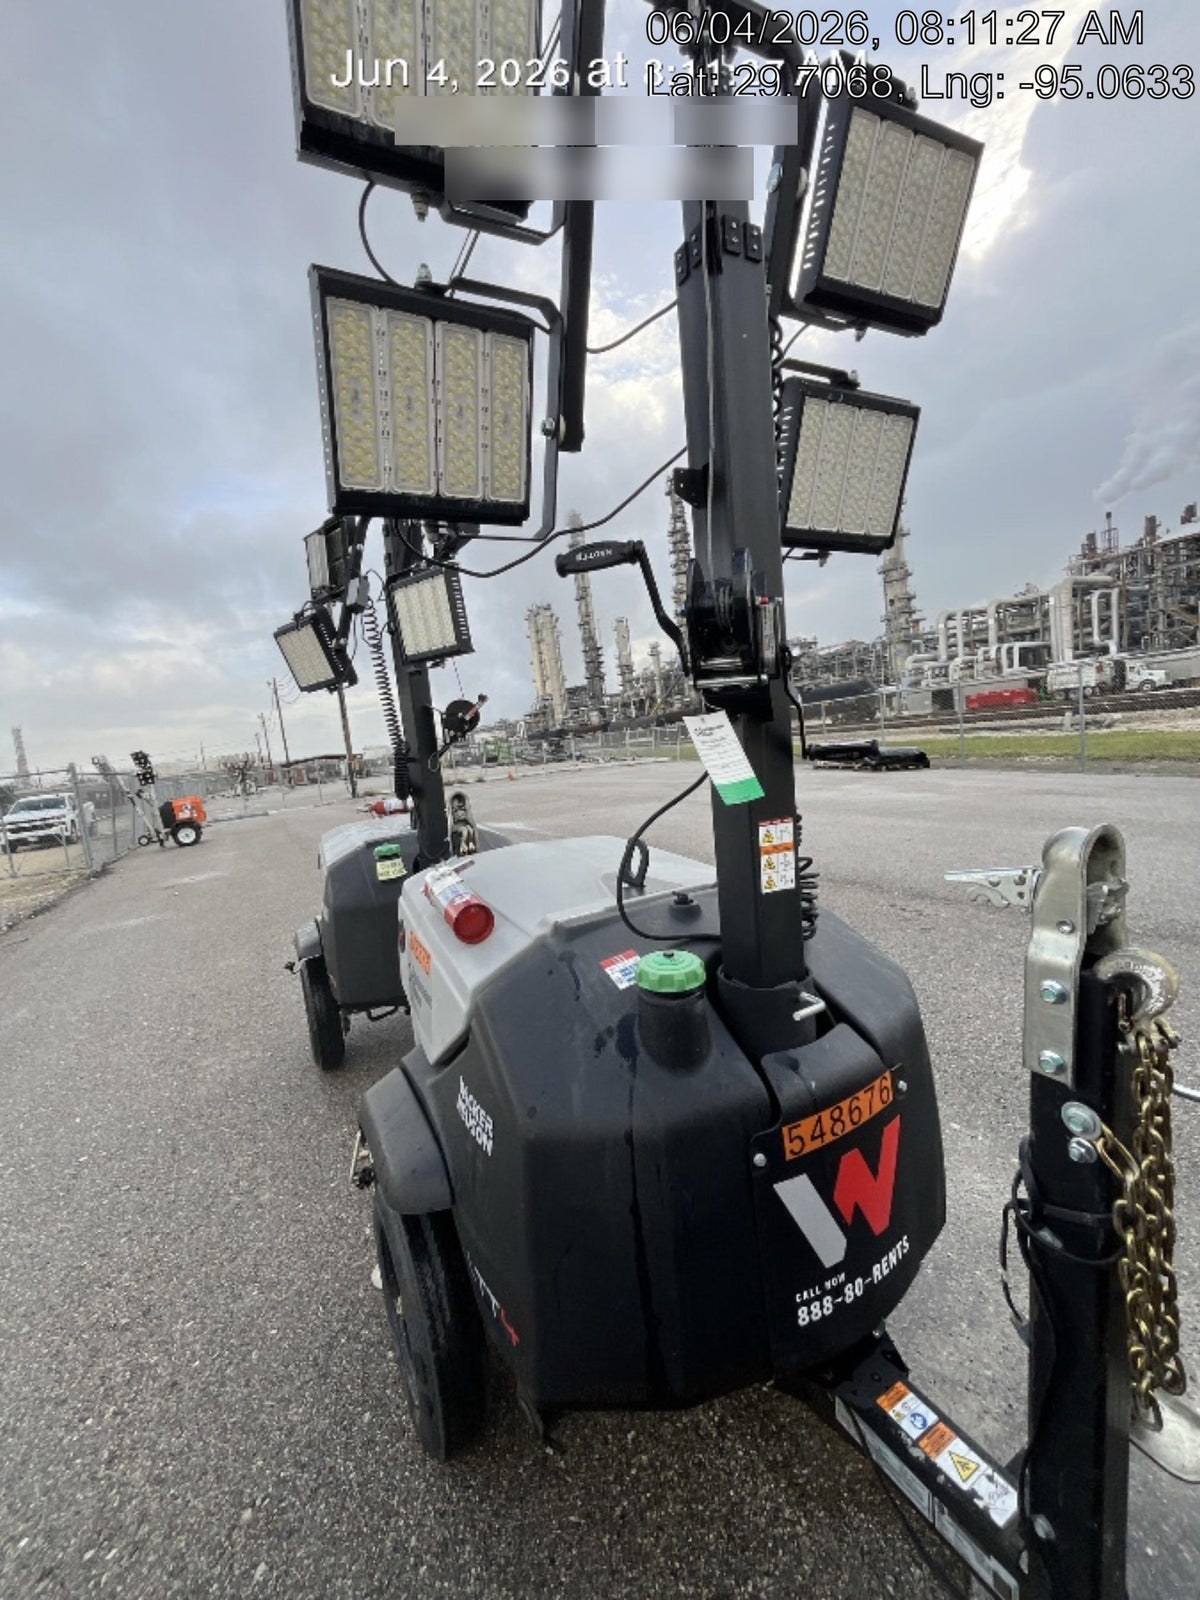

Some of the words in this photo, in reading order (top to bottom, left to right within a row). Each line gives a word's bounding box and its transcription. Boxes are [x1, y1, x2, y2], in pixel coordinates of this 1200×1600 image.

[787, 1074, 891, 1157] 548676
[795, 1285, 822, 1303] CALL
[824, 1272, 846, 1290] NOW
[797, 1234, 910, 1327] 888-80-RENTS
